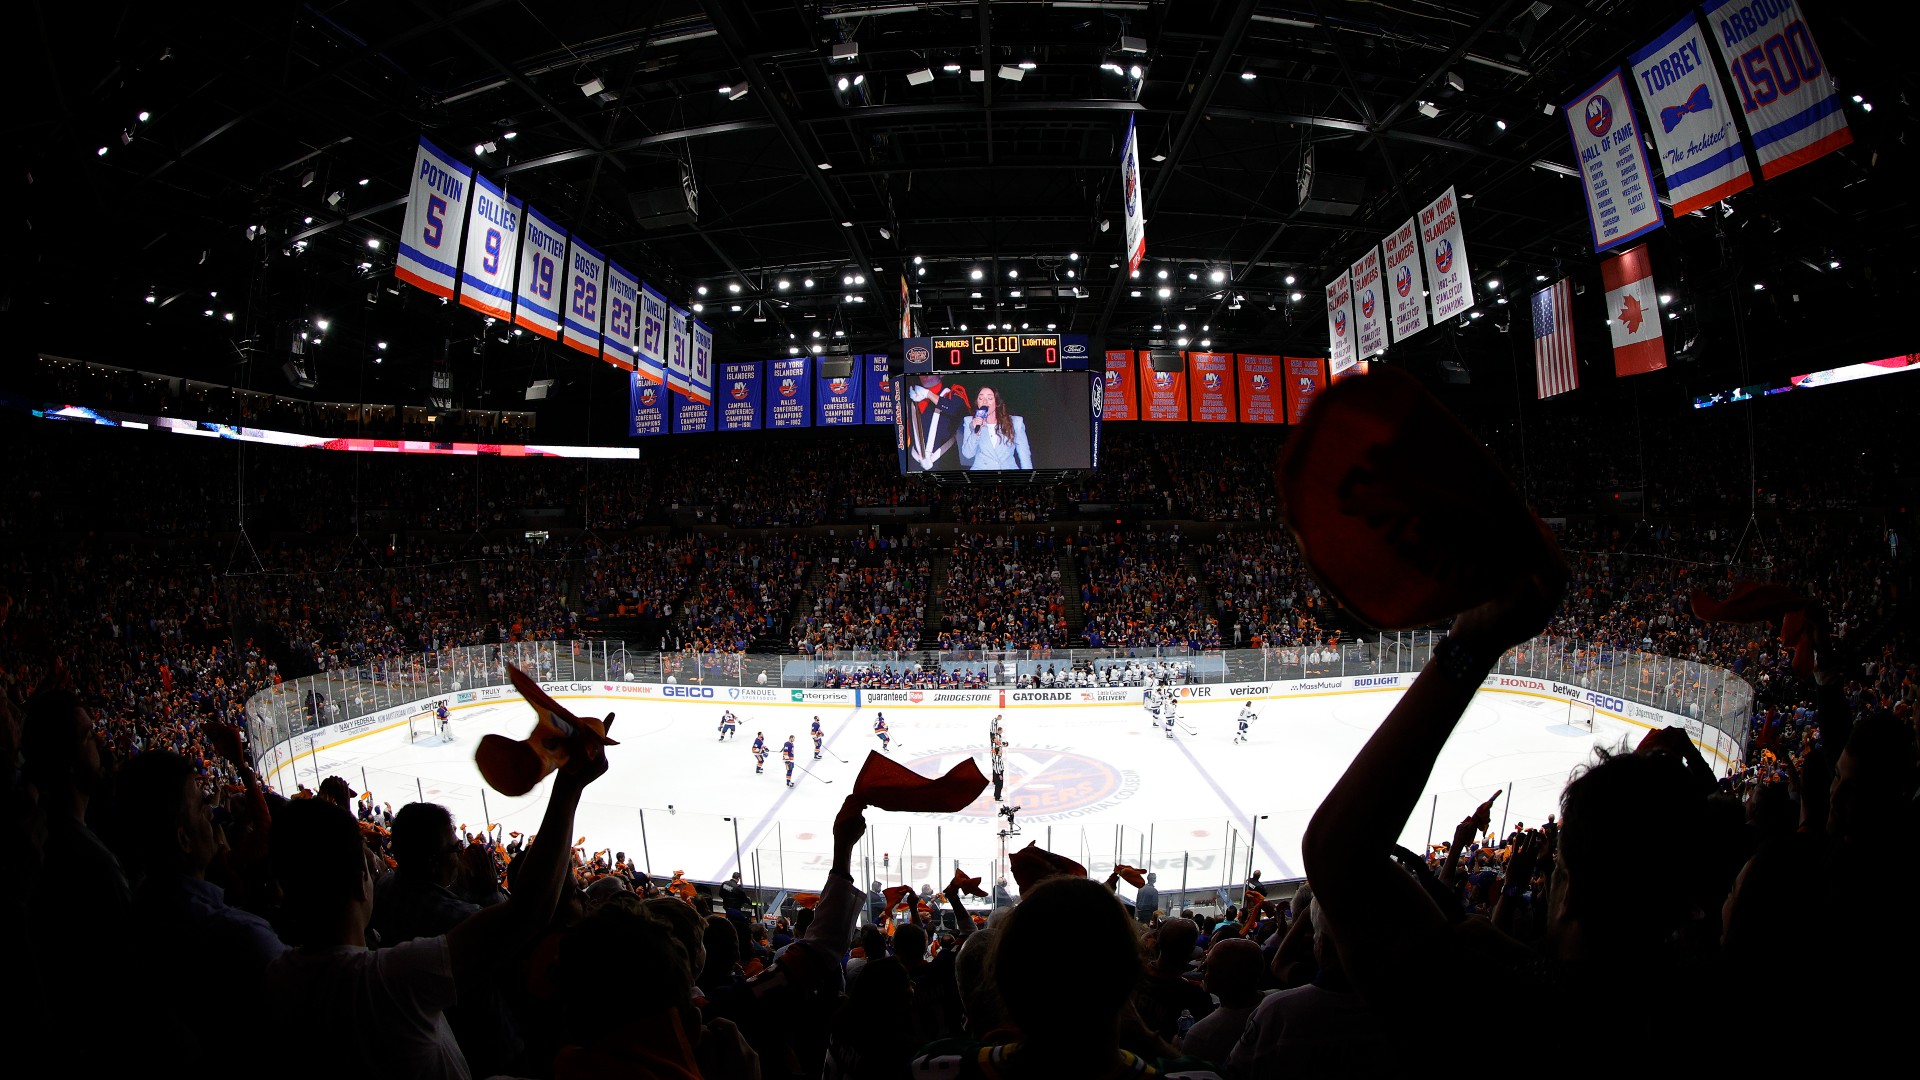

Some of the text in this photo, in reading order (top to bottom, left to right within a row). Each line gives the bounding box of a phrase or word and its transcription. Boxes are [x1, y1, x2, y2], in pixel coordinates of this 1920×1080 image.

[1641, 37, 1702, 96] TORREY
[1731, 19, 1822, 114] 1500
[1581, 122, 1634, 164] HALL OF FAME
[420, 159, 463, 202] POTVIN
[478, 195, 517, 232] GILLIES
[1421, 192, 1453, 226] NEW YORK
[423, 192, 448, 249] 5
[1423, 211, 1457, 244] ISLANDERS
[528, 223, 564, 260] TROTTIER
[1385, 223, 1412, 254] NEW YORK
[482, 227, 502, 276] 9
[1387, 240, 1415, 270] ISLANDERS
[574, 252, 600, 281] BOSSY
[1354, 251, 1377, 278] NEW YORK
[530, 251, 554, 301] 19
[1355, 267, 1379, 292] ISLANDERS
[572, 274, 597, 323] 22
[1435, 288, 1454, 305] STANLEY
[643, 294, 665, 322] TONELLI
[1438, 295, 1464, 317] CHAMPIONS
[610, 296, 632, 339] 23
[644, 316, 662, 355] 27
[1398, 318, 1421, 336] CHAMPIONS
[673, 333, 686, 369] 31
[935, 336, 1057, 352] ISLANDERS 20:00 LIGHTNING
[696, 347, 708, 380] 91
[873, 356, 887, 364] NEW
[950, 349, 961, 365] 0
[1046, 347, 1056, 363] 0
[726, 364, 755, 373] NEW YORK
[774, 368, 804, 377] ISLANDERS
[788, 360, 803, 368] YORK
[726, 372, 755, 380] ISLANDERS
[1093, 383, 1102, 410] Ford
[679, 410, 708, 418] CONFERENCE
[725, 408, 755, 416] CONFERENCE
[773, 405, 803, 413] CONFERENCE
[823, 402, 855, 410] CONFERENCE
[680, 417, 707, 425] CHAMPIONS
[541, 683, 592, 693] Great Clips
[1299, 681, 1342, 690] MassMutual
[1354, 676, 1399, 687] BUD LIGHT
[1500, 678, 1546, 690] HONDA
[481, 688, 501, 696] TRULY
[662, 686, 714, 698] GEICO
[793, 691, 848, 701] enterprise
[867, 691, 924, 703] guaranteed Rate
[933, 693, 992, 702] BRIDGESTONE
[1012, 692, 1072, 701] GATORADE
[1163, 686, 1211, 698] ISCOVER
[1229, 685, 1269, 696] verizon
[1552, 683, 1581, 699] betway
[1586, 692, 1624, 713] GEICO
[339, 716, 376, 731] NAVY FEDERAL
[1016, 799, 1121, 824] MEMORIAL
[1118, 769, 1141, 801] COLISEUM
